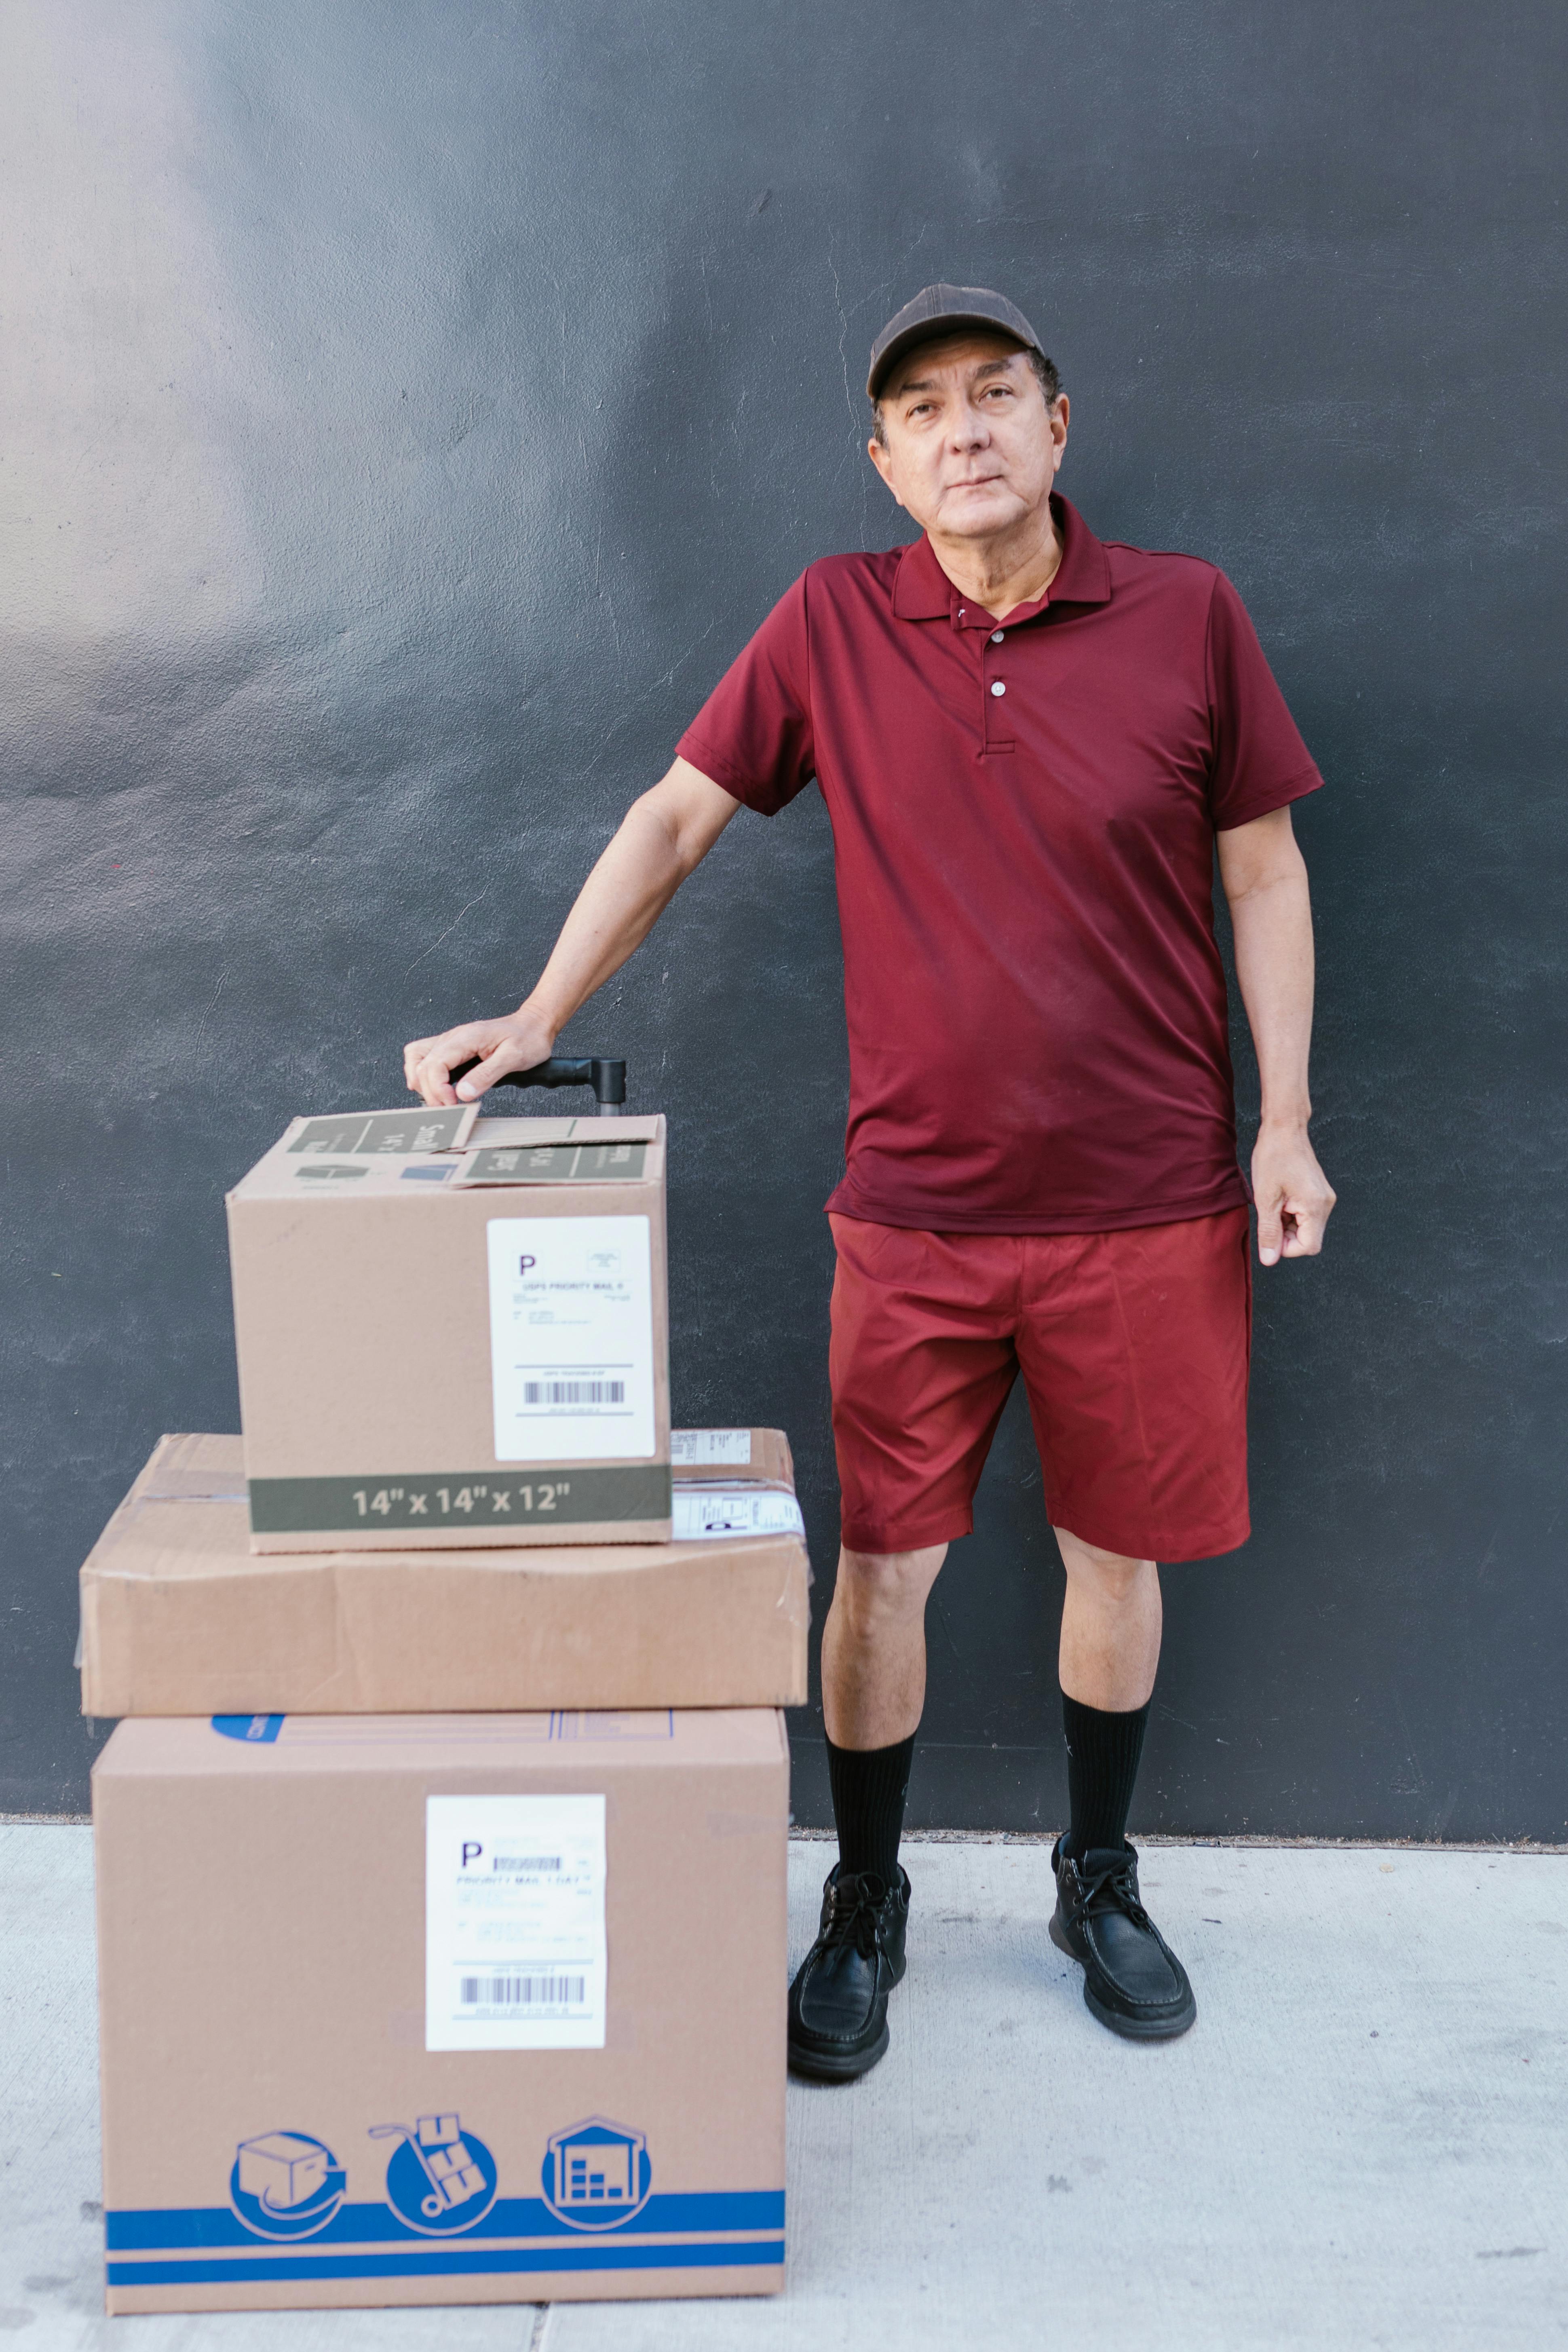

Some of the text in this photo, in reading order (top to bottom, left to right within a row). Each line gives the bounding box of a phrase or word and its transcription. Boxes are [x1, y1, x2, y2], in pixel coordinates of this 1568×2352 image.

[411, 1124, 445, 1151] Small
[520, 1254, 536, 1276] P
[352, 1482, 570, 1516] 14" x 14" x 12"
[462, 1842, 482, 1868] P
